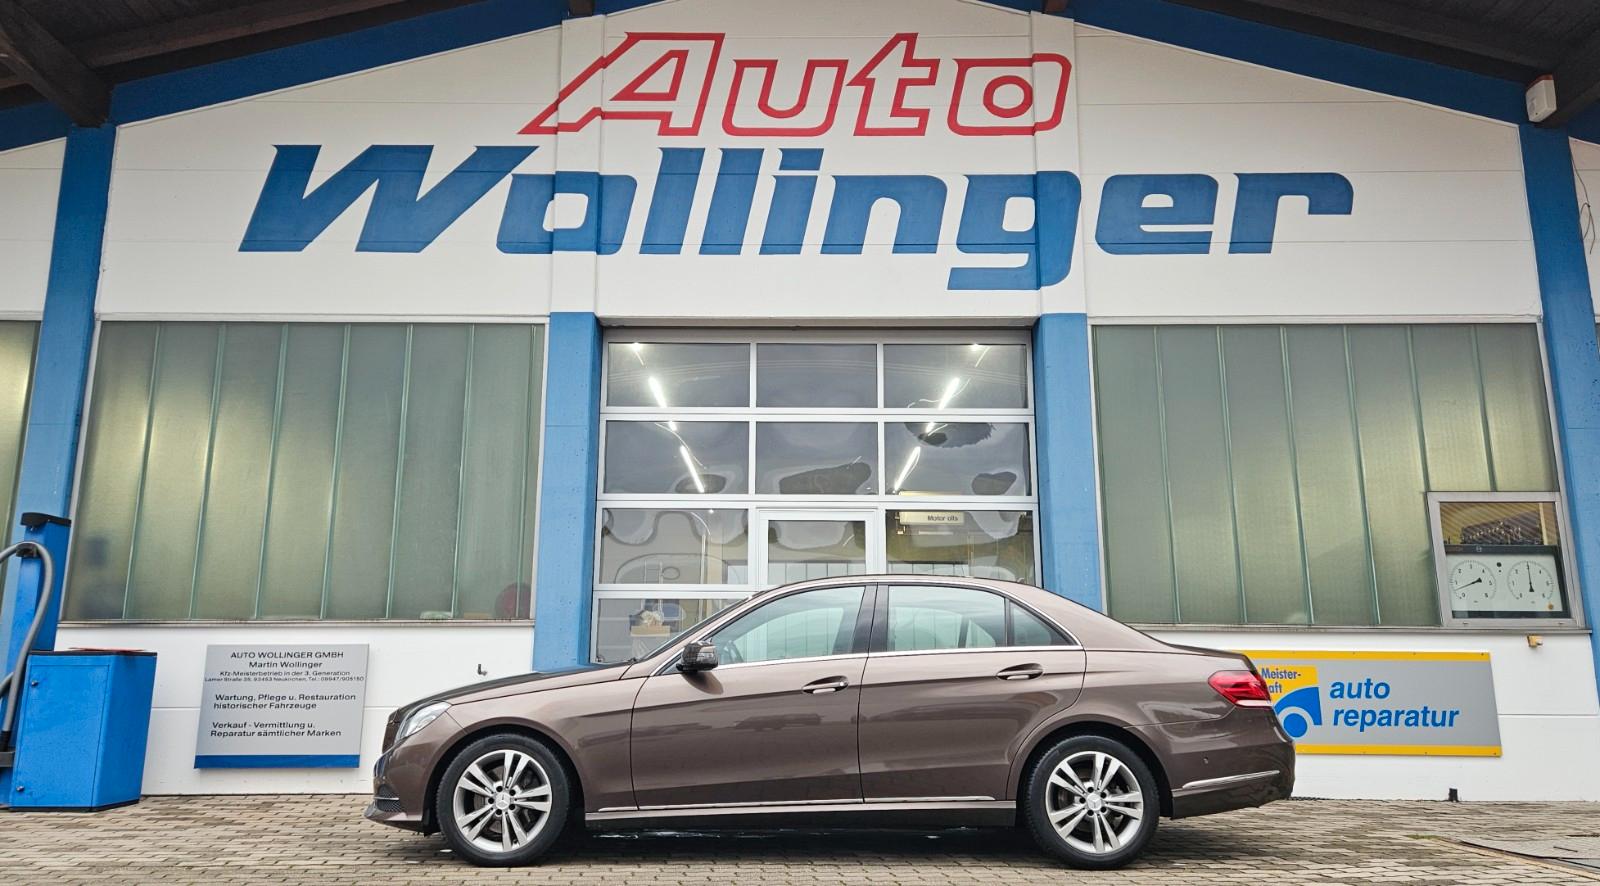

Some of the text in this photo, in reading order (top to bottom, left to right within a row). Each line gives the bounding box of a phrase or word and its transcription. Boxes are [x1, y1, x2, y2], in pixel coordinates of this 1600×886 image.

[518, 31, 1073, 137] Auto
[238, 144, 1354, 291] Wollinger
[230, 651, 344, 659] AUTO WOLLINGER GMBH
[248, 660, 323, 669] Martin Wollinger
[1261, 667, 1301, 680] Meister-
[1266, 682, 1282, 694] aft
[1329, 678, 1391, 700] auto
[215, 693, 256, 702] Wartung,
[257, 693, 287, 702] Pflege
[298, 693, 356, 701] Restauration
[269, 702, 317, 710] Fahrzeuge
[1332, 706, 1460, 733] reparatur
[212, 721, 248, 729] Verkauf
[253, 721, 306, 730] Vermittlung
[210, 730, 256, 738] Reparatur
[257, 729, 305, 737] sämtlicher
